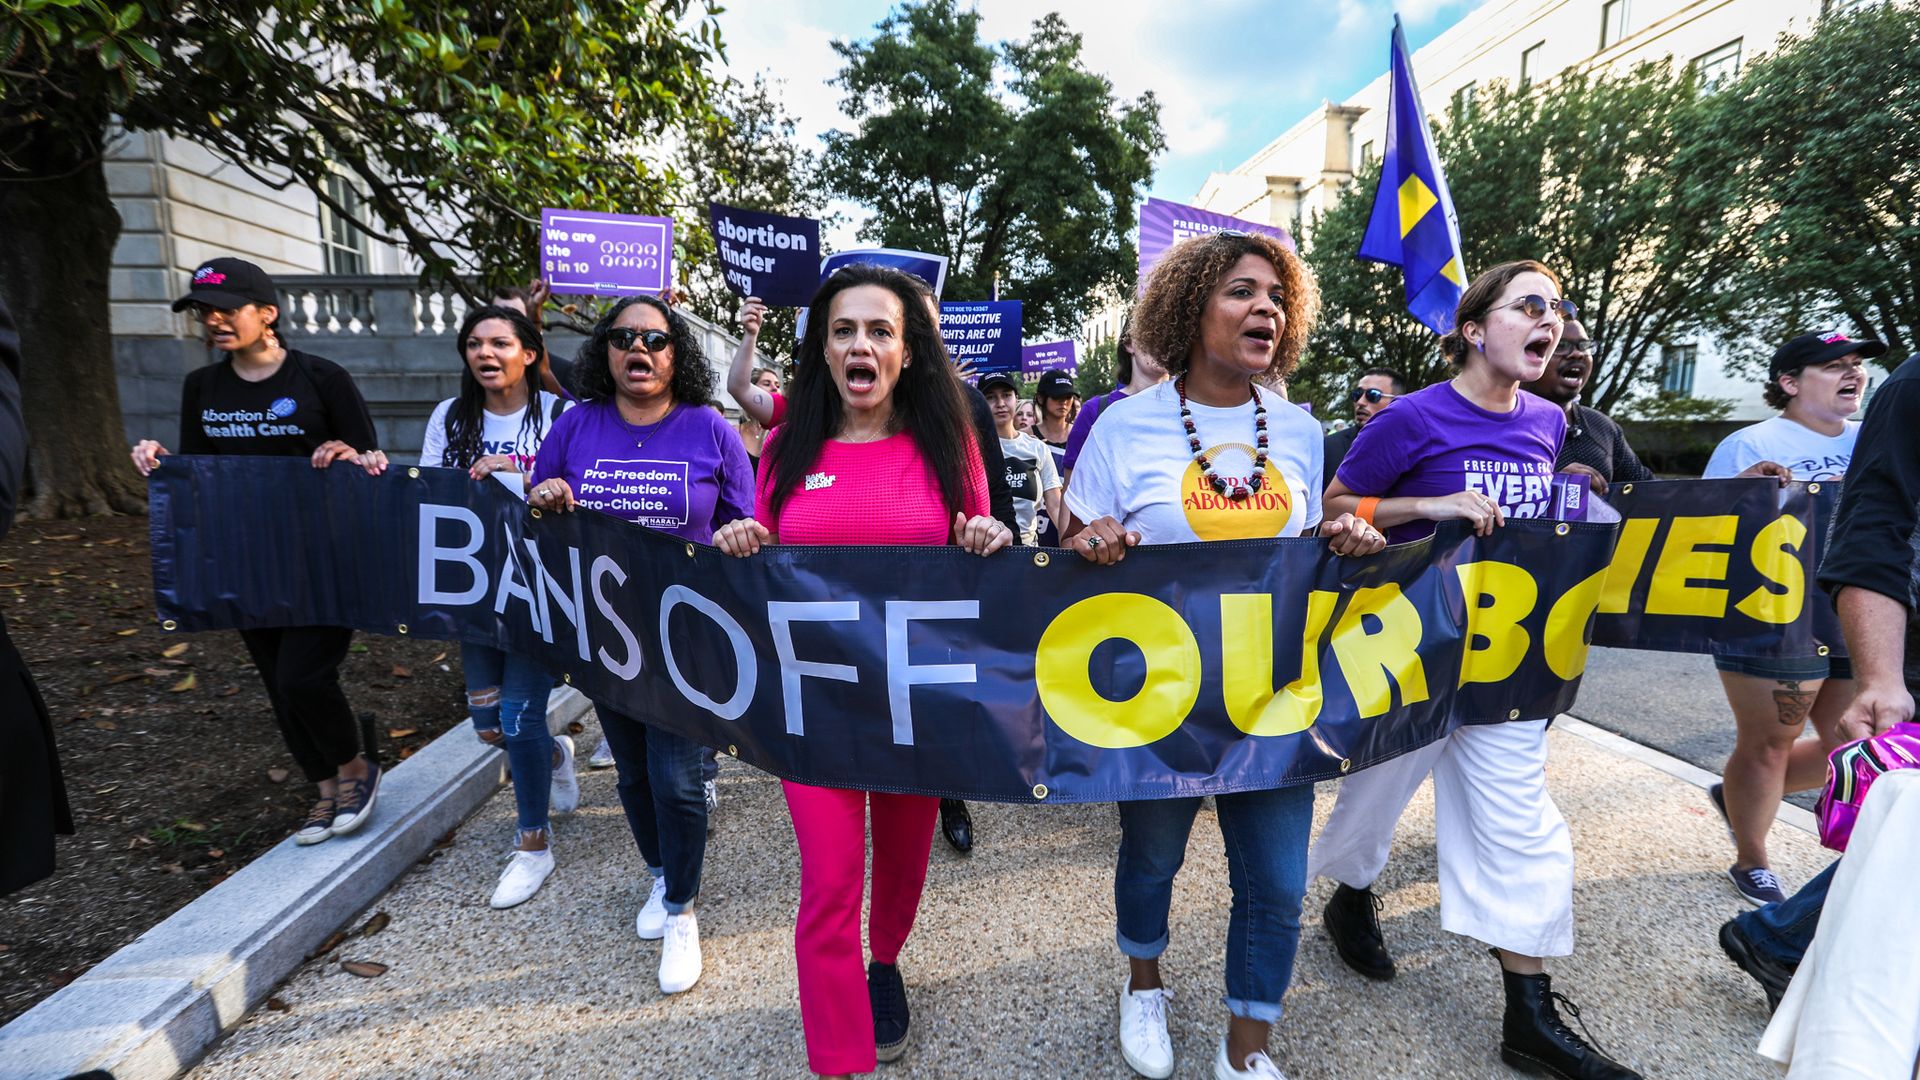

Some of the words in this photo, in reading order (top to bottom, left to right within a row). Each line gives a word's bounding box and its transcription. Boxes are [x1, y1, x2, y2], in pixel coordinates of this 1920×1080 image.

[546, 229, 569, 241] We
[572, 232, 596, 243] are
[718, 216, 807, 251] abortion
[545, 245, 571, 257] the
[721, 240, 775, 273] finder
[545, 261, 554, 271] 8
[557, 260, 570, 272] in
[573, 263, 589, 273] 10
[727, 269, 752, 295] .org
[939, 313, 1002, 324] EPRODUCTIVE
[940, 329, 965, 339] IGHTS
[966, 330, 986, 339] ARE
[987, 328, 1001, 338] ON
[960, 344, 994, 354] BALLOT
[1040, 357, 1067, 365] majority
[257, 423, 305, 436] Care.
[1464, 460, 1519, 473] FREEDOM
[1523, 463, 1534, 473] IS
[583, 469, 682, 481] Pro-Freedom.
[580, 483, 672, 495] Pro-Justice.
[418, 503, 642, 681] BANS
[660, 584, 980, 746] OFF
[1035, 582, 1430, 749] OUR
